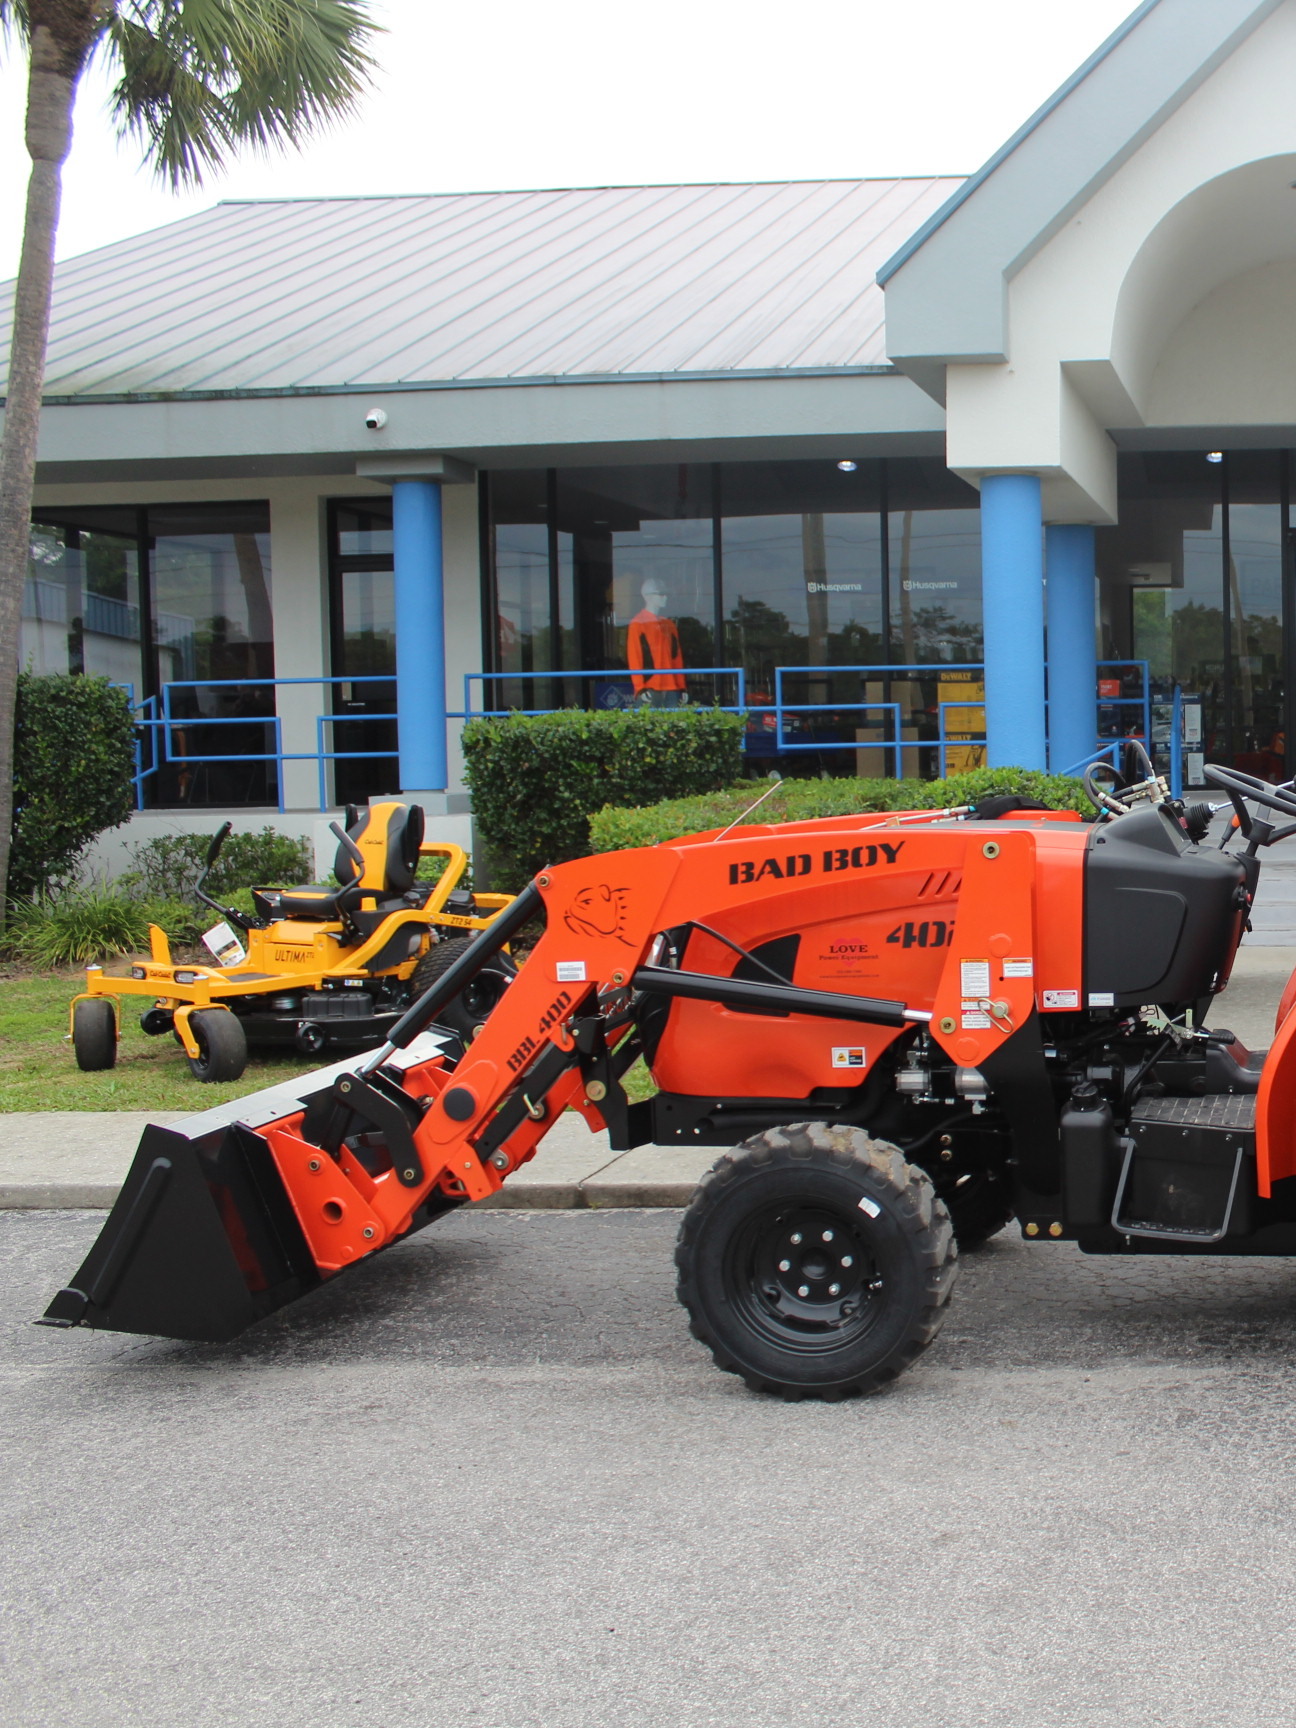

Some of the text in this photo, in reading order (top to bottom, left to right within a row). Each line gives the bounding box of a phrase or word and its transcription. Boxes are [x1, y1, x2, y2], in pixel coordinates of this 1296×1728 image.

[728, 840, 906, 885] BAD BOY
[275, 950, 305, 963] ULTIMA
[829, 944, 868, 954] LOVE
[506, 1036, 540, 1073] BBL
[539, 991, 572, 1034] 400
